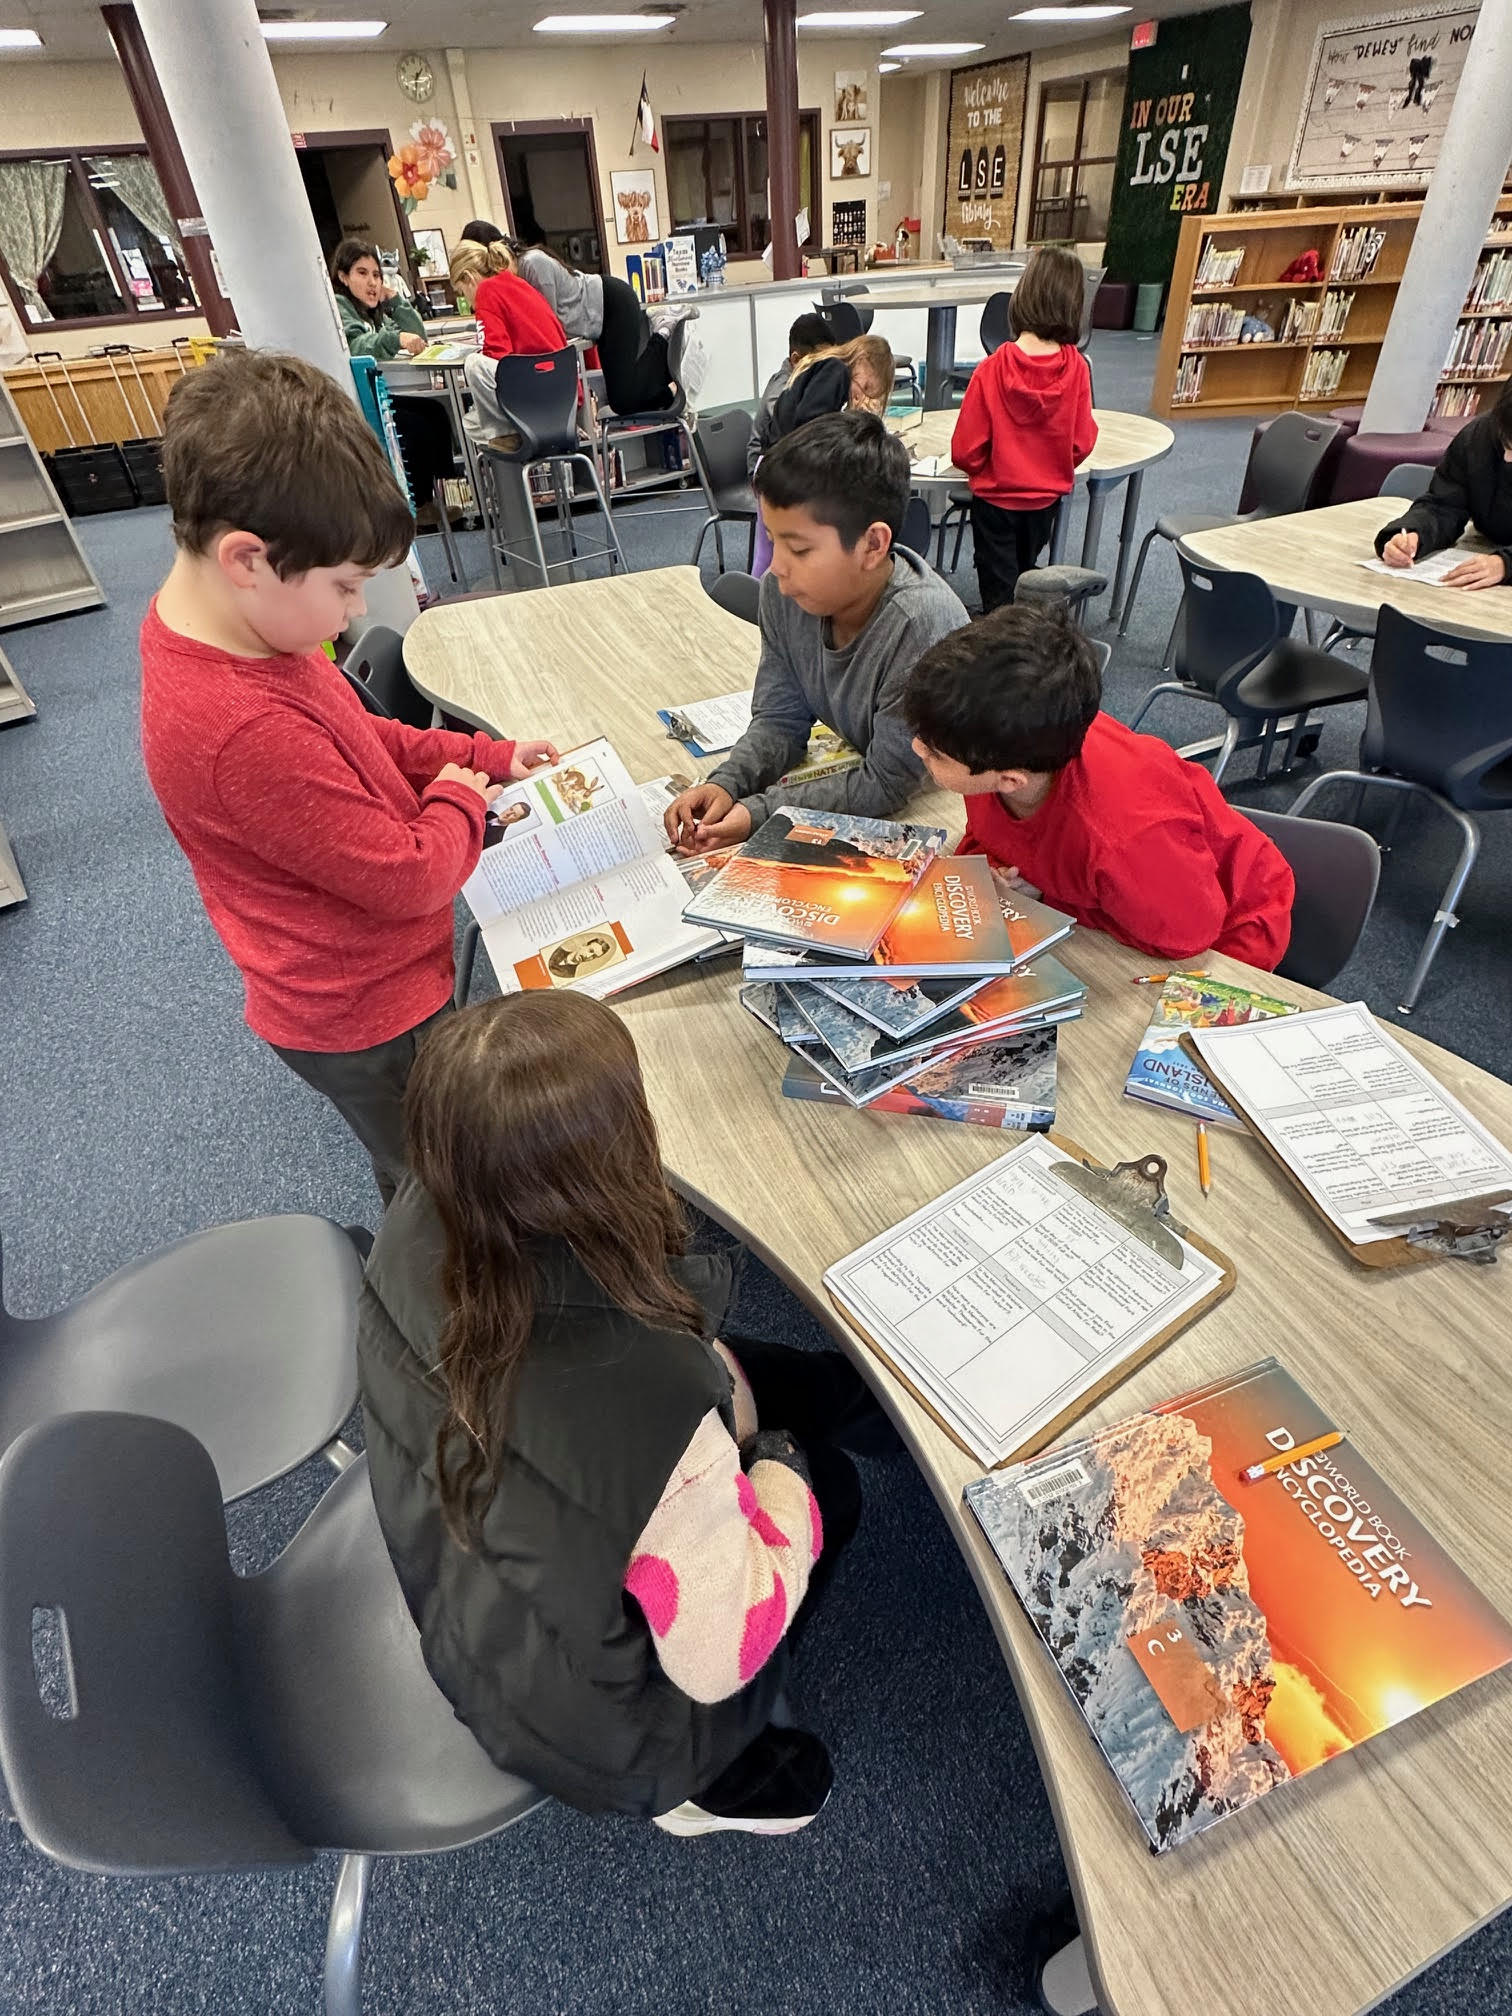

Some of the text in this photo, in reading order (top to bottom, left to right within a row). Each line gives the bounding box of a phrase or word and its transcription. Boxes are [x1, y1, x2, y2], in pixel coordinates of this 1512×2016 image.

[967, 108, 1003, 128] TO THE
[1130, 92, 1195, 129] IN OUR
[1130, 124, 1209, 186] LSE
[1170, 181, 1210, 211] ERA
[813, 765, 837, 777] NATE
[933, 882, 951, 932] ENCYCLOPEDIA
[944, 875, 975, 940] DISCOVERY
[1265, 1426, 1432, 1607] DSCOVERY
[1271, 1466, 1382, 1598] NCYCLOPEDIA
[1324, 1462, 1412, 1561] WORLD BOOK
[1147, 1639, 1166, 1656] C
[1167, 1629, 1183, 1643] 3
